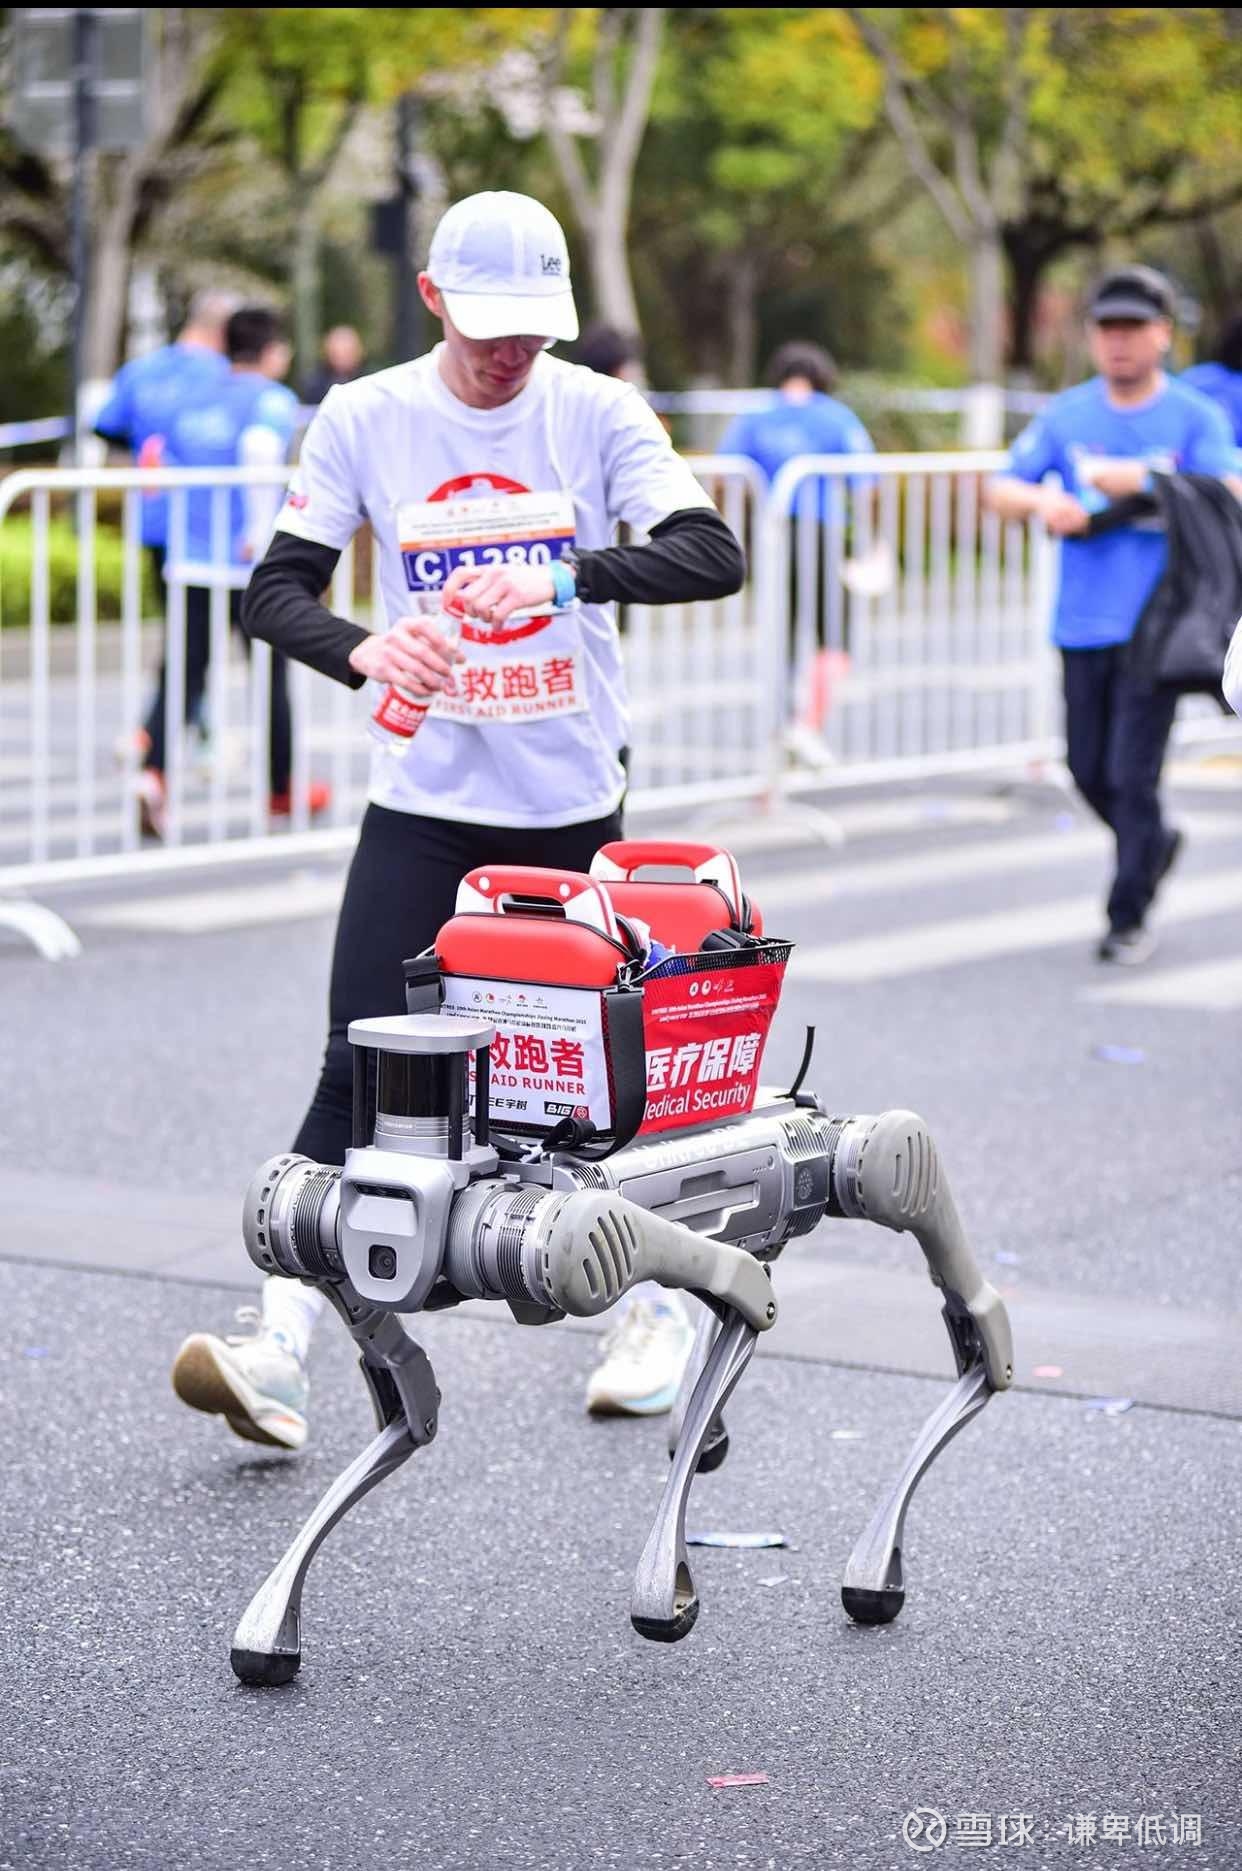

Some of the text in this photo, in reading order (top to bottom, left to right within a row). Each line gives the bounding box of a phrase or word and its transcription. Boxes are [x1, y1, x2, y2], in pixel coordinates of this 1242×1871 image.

[540, 253, 561, 272] Lee
[414, 551, 443, 585] C
[461, 657, 576, 703] 救跑者
[476, 704, 507, 718] AID
[512, 696, 577, 715] RUNNER
[467, 1030, 585, 1079] 救跑者
[645, 1032, 762, 1093] 医疗保障
[491, 1073, 518, 1088] AID
[523, 1077, 586, 1095] RUNNER
[692, 1082, 751, 1109] Security
[546, 1103, 573, 1116] BIG
